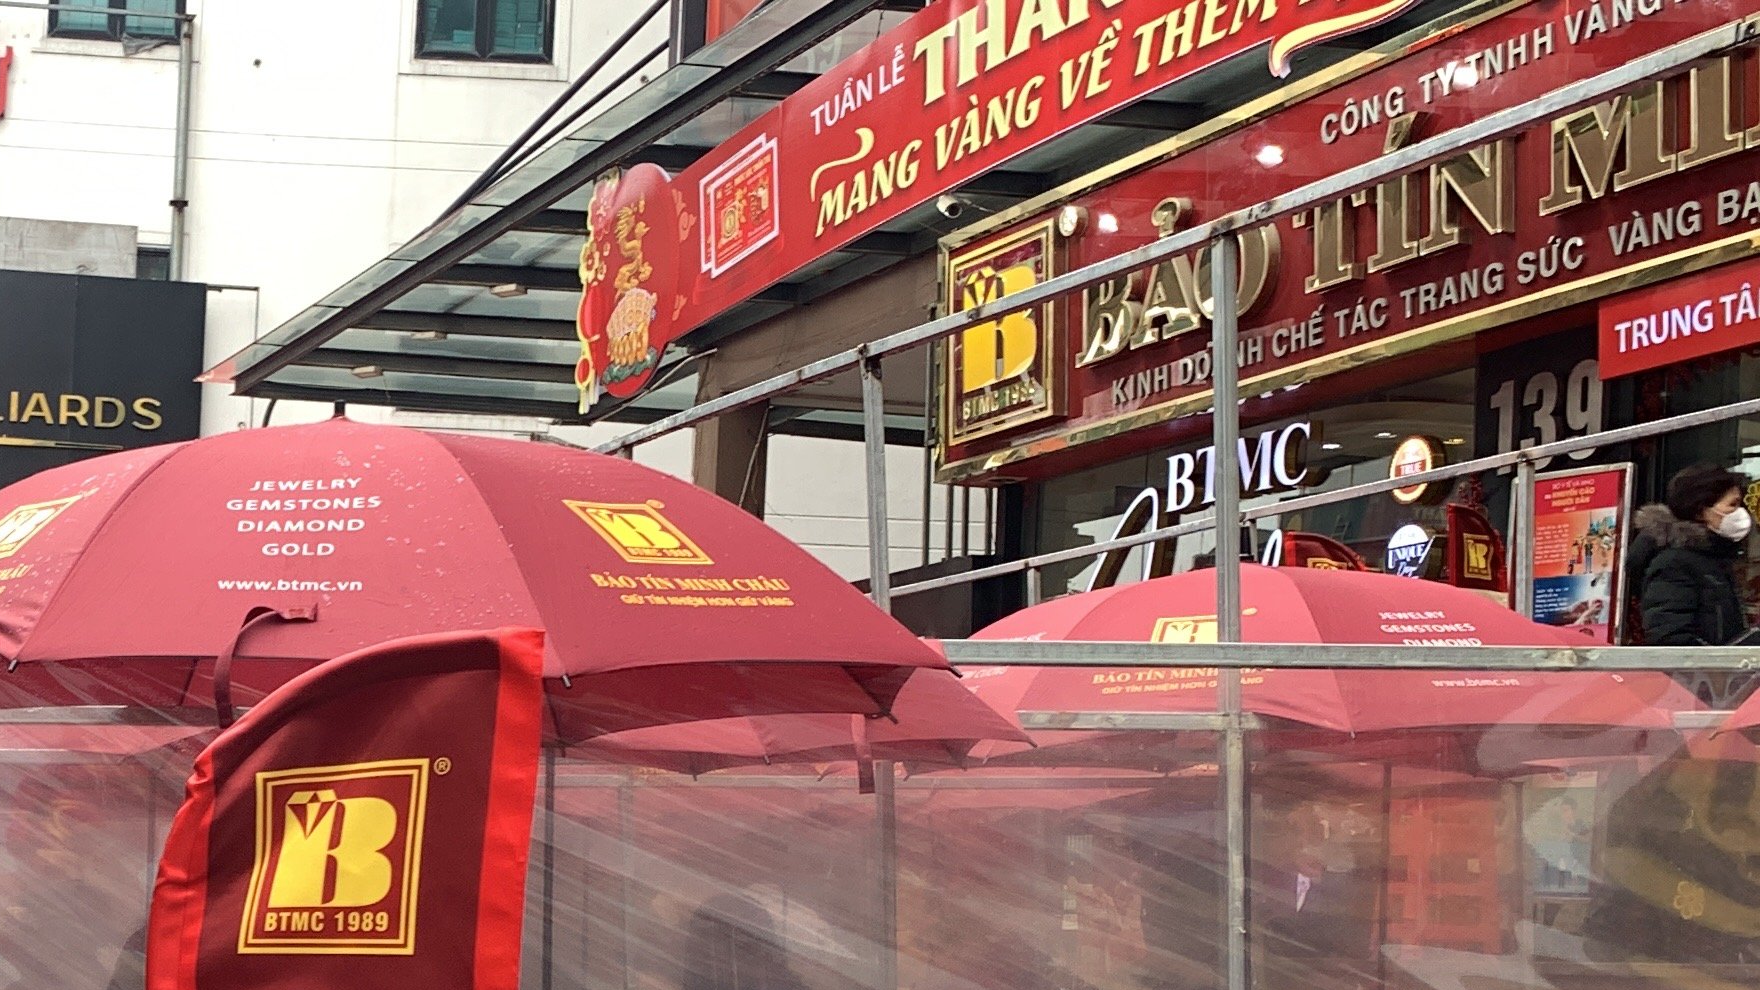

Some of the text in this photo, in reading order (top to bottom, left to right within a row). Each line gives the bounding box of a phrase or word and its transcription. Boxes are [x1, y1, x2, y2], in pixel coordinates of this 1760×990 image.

[810, 72, 874, 136] TUẦN
[877, 43, 907, 101] LỄ
[1320, 86, 1406, 145] CÔNG
[1418, 61, 1458, 104] TY
[1463, 23, 1554, 80] TNHH
[811, 130, 923, 238] MANG
[934, 75, 1046, 171] VÀNG
[1059, 18, 1123, 111] VỀ
[1539, 47, 1760, 217] MI
[1112, 180, 1760, 408] KINH DONH CHẾ TÁC TRANG SỨC VÀNG BẠ
[1614, 283, 1760, 353] TRUNG TÂ
[1490, 358, 1604, 477] 139
[1165, 421, 1312, 513] BTMC
[250, 477, 362, 491] JEWELRY
[226, 496, 382, 511] GEMSTONES
[237, 519, 366, 532] DIAMOND
[261, 543, 335, 556] GOLD
[217, 579, 363, 592] www.btmc.vn
[590, 571, 791, 592] BẢO TÍN MINH CHÂU
[1378, 609, 1447, 621] JEWELRY
[1380, 622, 1476, 634] GEMSTONES
[1170, 667, 1219, 680] MINH
[264, 911, 390, 932] BTMC 1989
